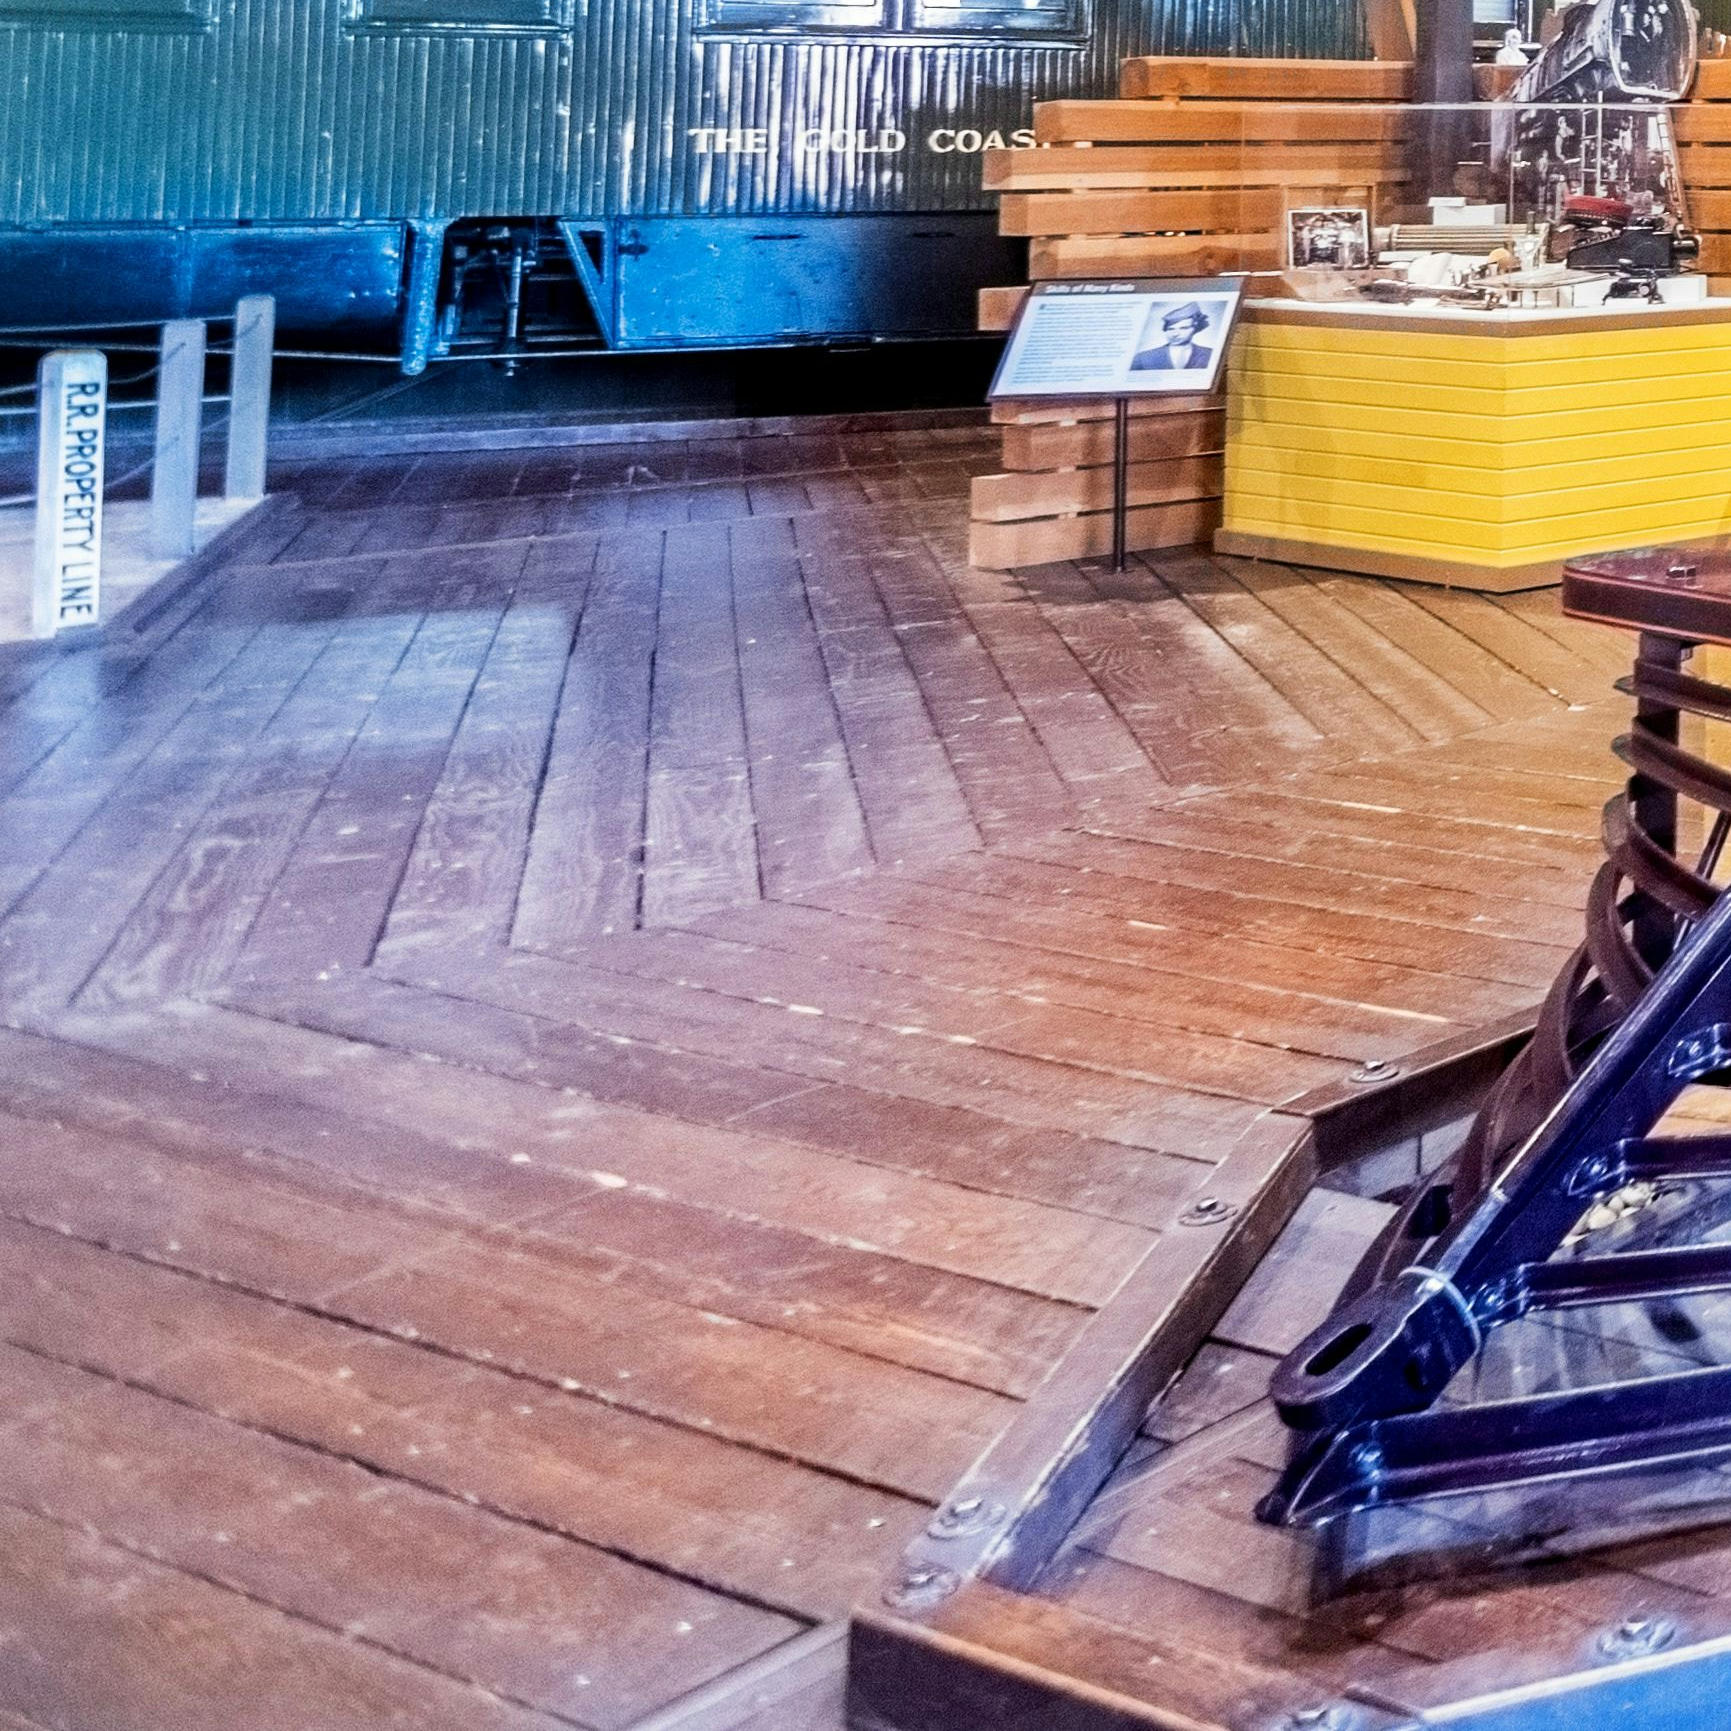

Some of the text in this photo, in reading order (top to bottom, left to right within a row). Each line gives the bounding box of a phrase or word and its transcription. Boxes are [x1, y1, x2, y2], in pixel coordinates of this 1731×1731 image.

[688, 128, 1051, 154] THE GOLD COAS
[60, 561, 94, 619] LINE
